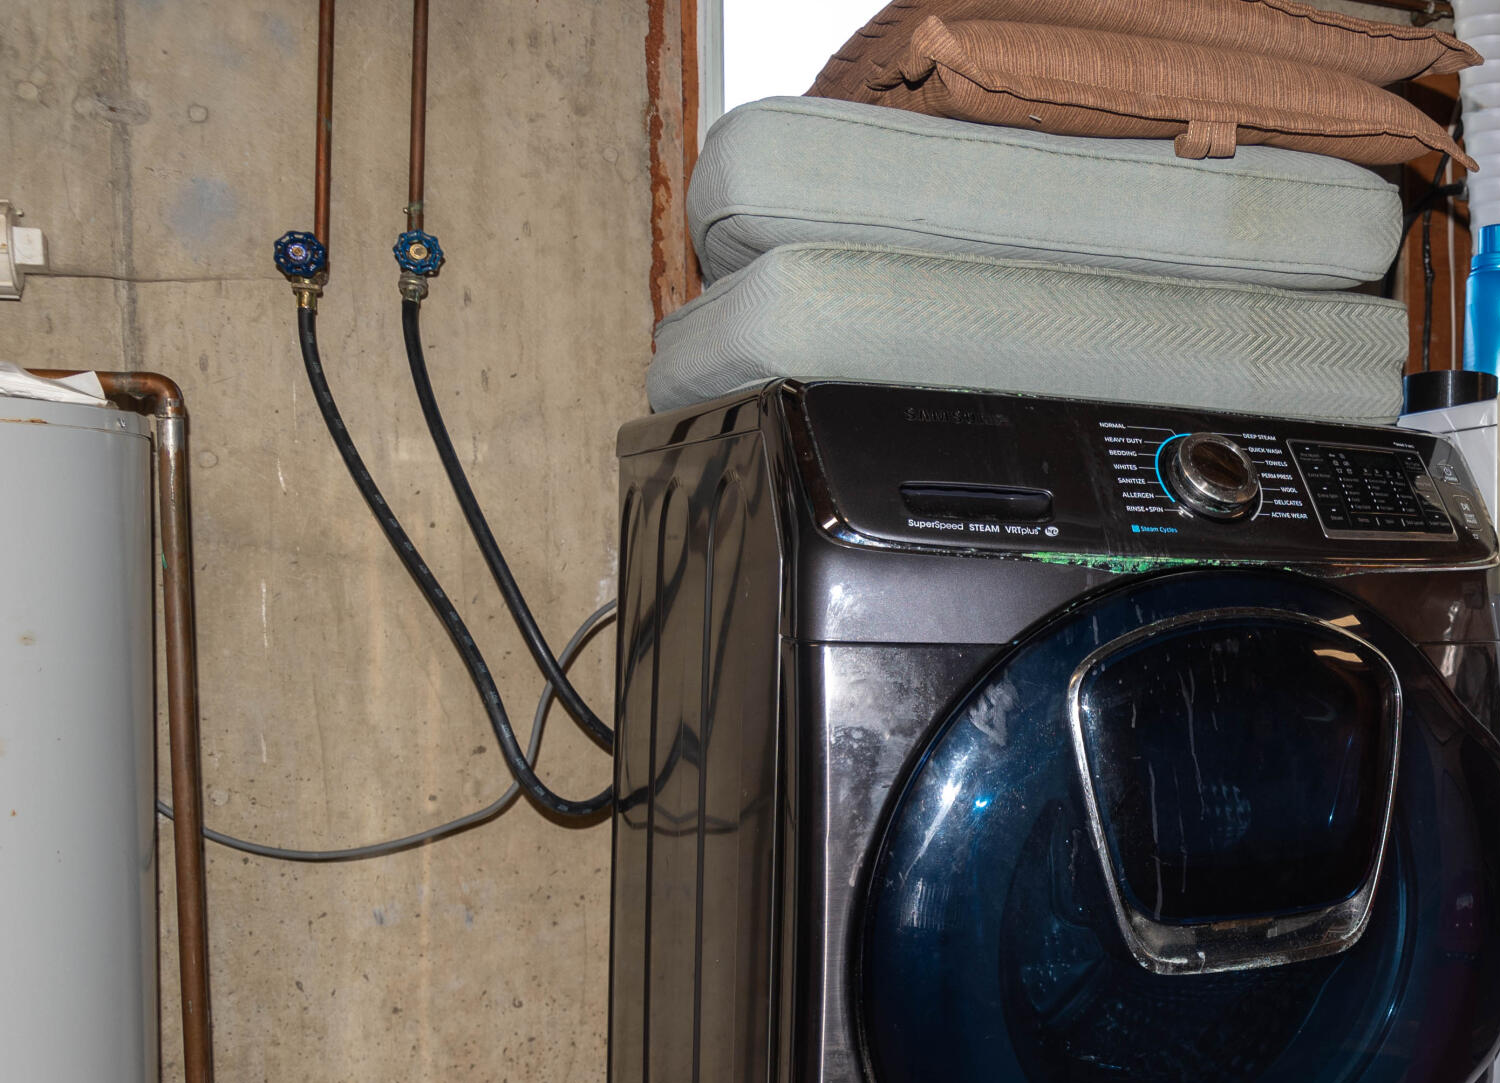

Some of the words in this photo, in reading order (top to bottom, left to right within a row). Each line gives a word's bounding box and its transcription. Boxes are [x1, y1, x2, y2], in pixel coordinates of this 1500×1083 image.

[1108, 449, 1138, 457] BEDDING
[1273, 499, 1303, 507] DELICATES
[908, 519, 964, 530] SuperSpeed
[969, 523, 1000, 533] STEAM
[1140, 525, 1159, 533] Steam
[1159, 526, 1178, 534] Cycles
